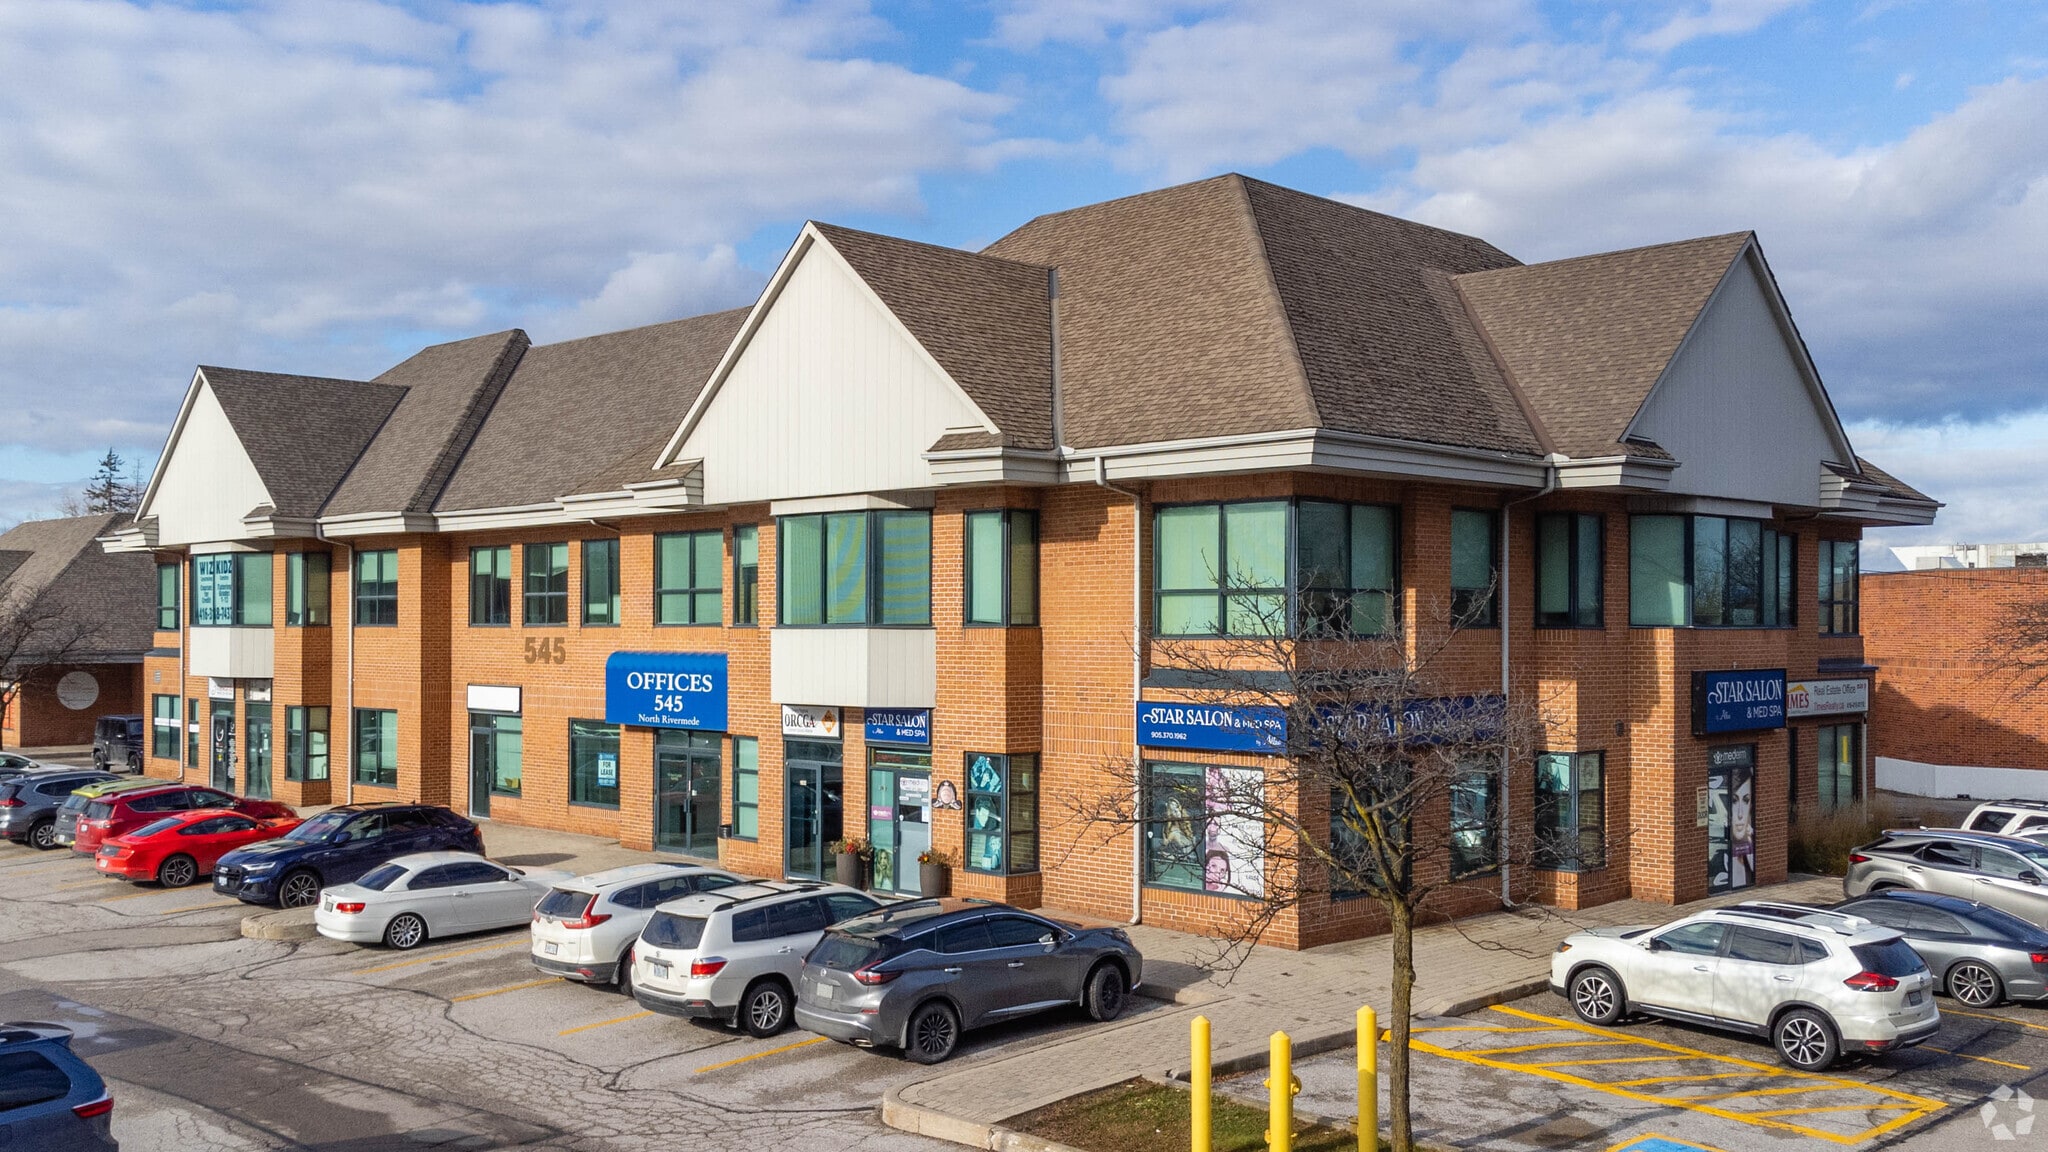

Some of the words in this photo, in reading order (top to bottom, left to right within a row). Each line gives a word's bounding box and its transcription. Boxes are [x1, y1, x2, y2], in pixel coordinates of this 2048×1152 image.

[199, 561, 214, 575] WIZ
[216, 560, 232, 574] KIDZ
[524, 637, 566, 664] 545
[627, 672, 713, 692] OFFICES
[1814, 685, 1825, 695] Real
[1826, 684, 1841, 695] Estate
[1842, 683, 1856, 694] Office
[1708, 681, 1744, 704] STAR
[1745, 680, 1782, 702] SALON
[654, 695, 683, 712] 545
[1786, 692, 1809, 709] IMES
[1142, 707, 1185, 725] STAR
[1186, 709, 1233, 727] SALON
[1234, 719, 1241, 728] &
[1264, 719, 1282, 730] SPA
[1746, 706, 1752, 718] &
[1753, 705, 1769, 718] MED
[1769, 705, 1782, 717] SPA
[638, 714, 660, 723] North
[662, 715, 700, 726] Rivermede
[866, 713, 895, 726] STAR
[895, 714, 926, 728] SALON
[901, 729, 914, 737] MED
[914, 729, 926, 738] SPA
